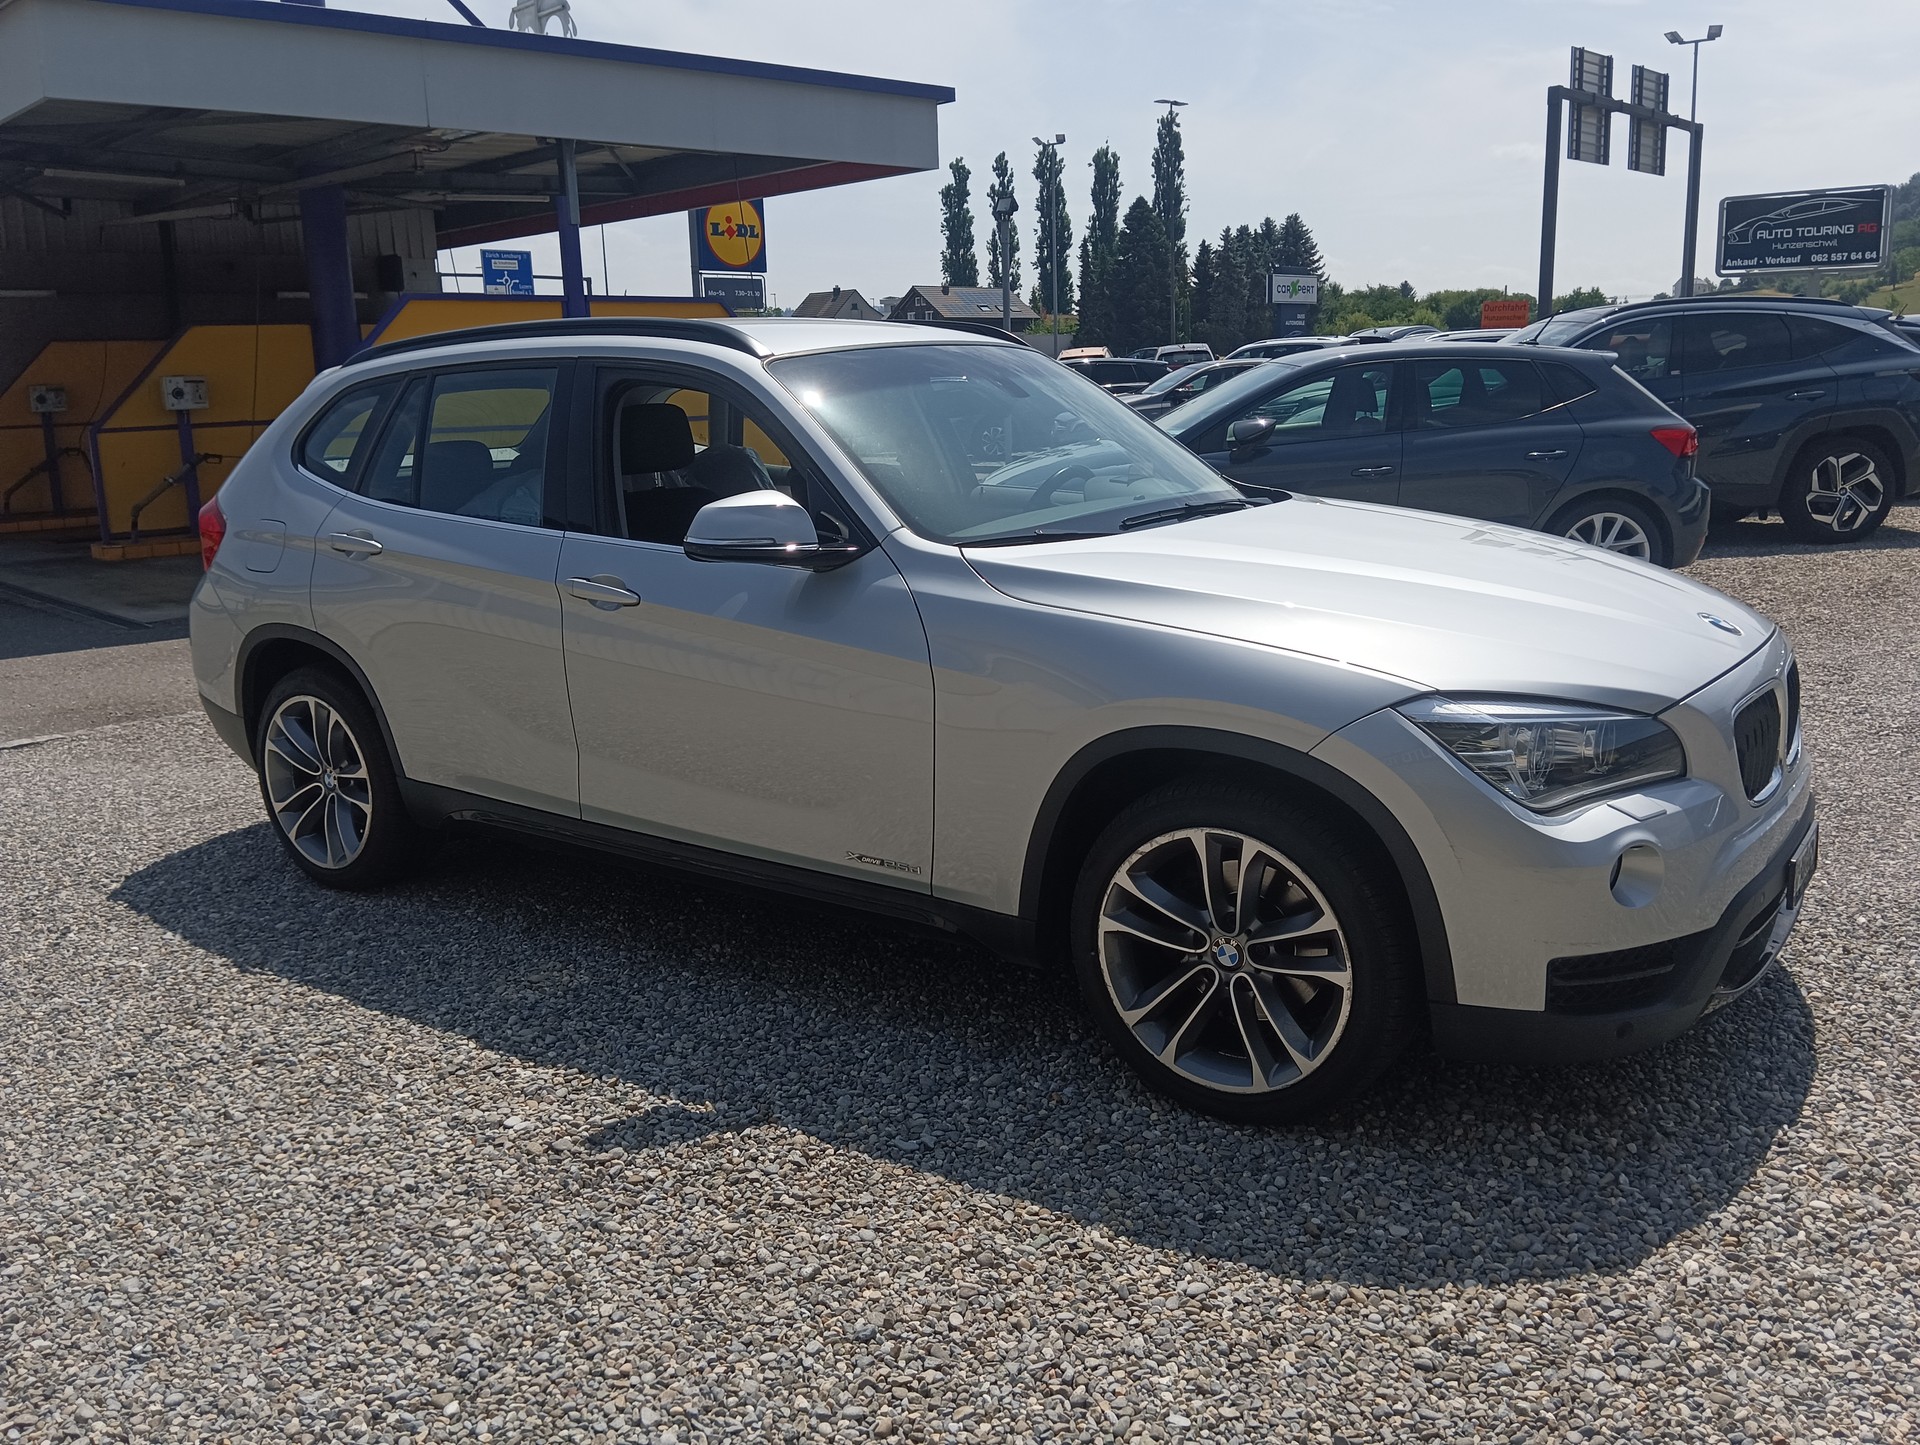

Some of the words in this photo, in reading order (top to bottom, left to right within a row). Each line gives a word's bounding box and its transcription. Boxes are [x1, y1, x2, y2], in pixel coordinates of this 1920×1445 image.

[1756, 227, 1793, 240] AUTO
[1796, 224, 1854, 237] TOURING
[1857, 223, 1878, 233] AG
[1772, 238, 1838, 250] Hunzenschwil
[1725, 257, 1758, 267] Ankauf
[1765, 255, 1801, 265] Verkauf
[1811, 252, 1828, 262] 062
[1831, 252, 1848, 262] 557
[1850, 251, 1862, 261] 64
[1865, 250, 1877, 260] 64
[1483, 303, 1528, 312] Durchfahrt
[1211, 938, 1238, 953] BMW
